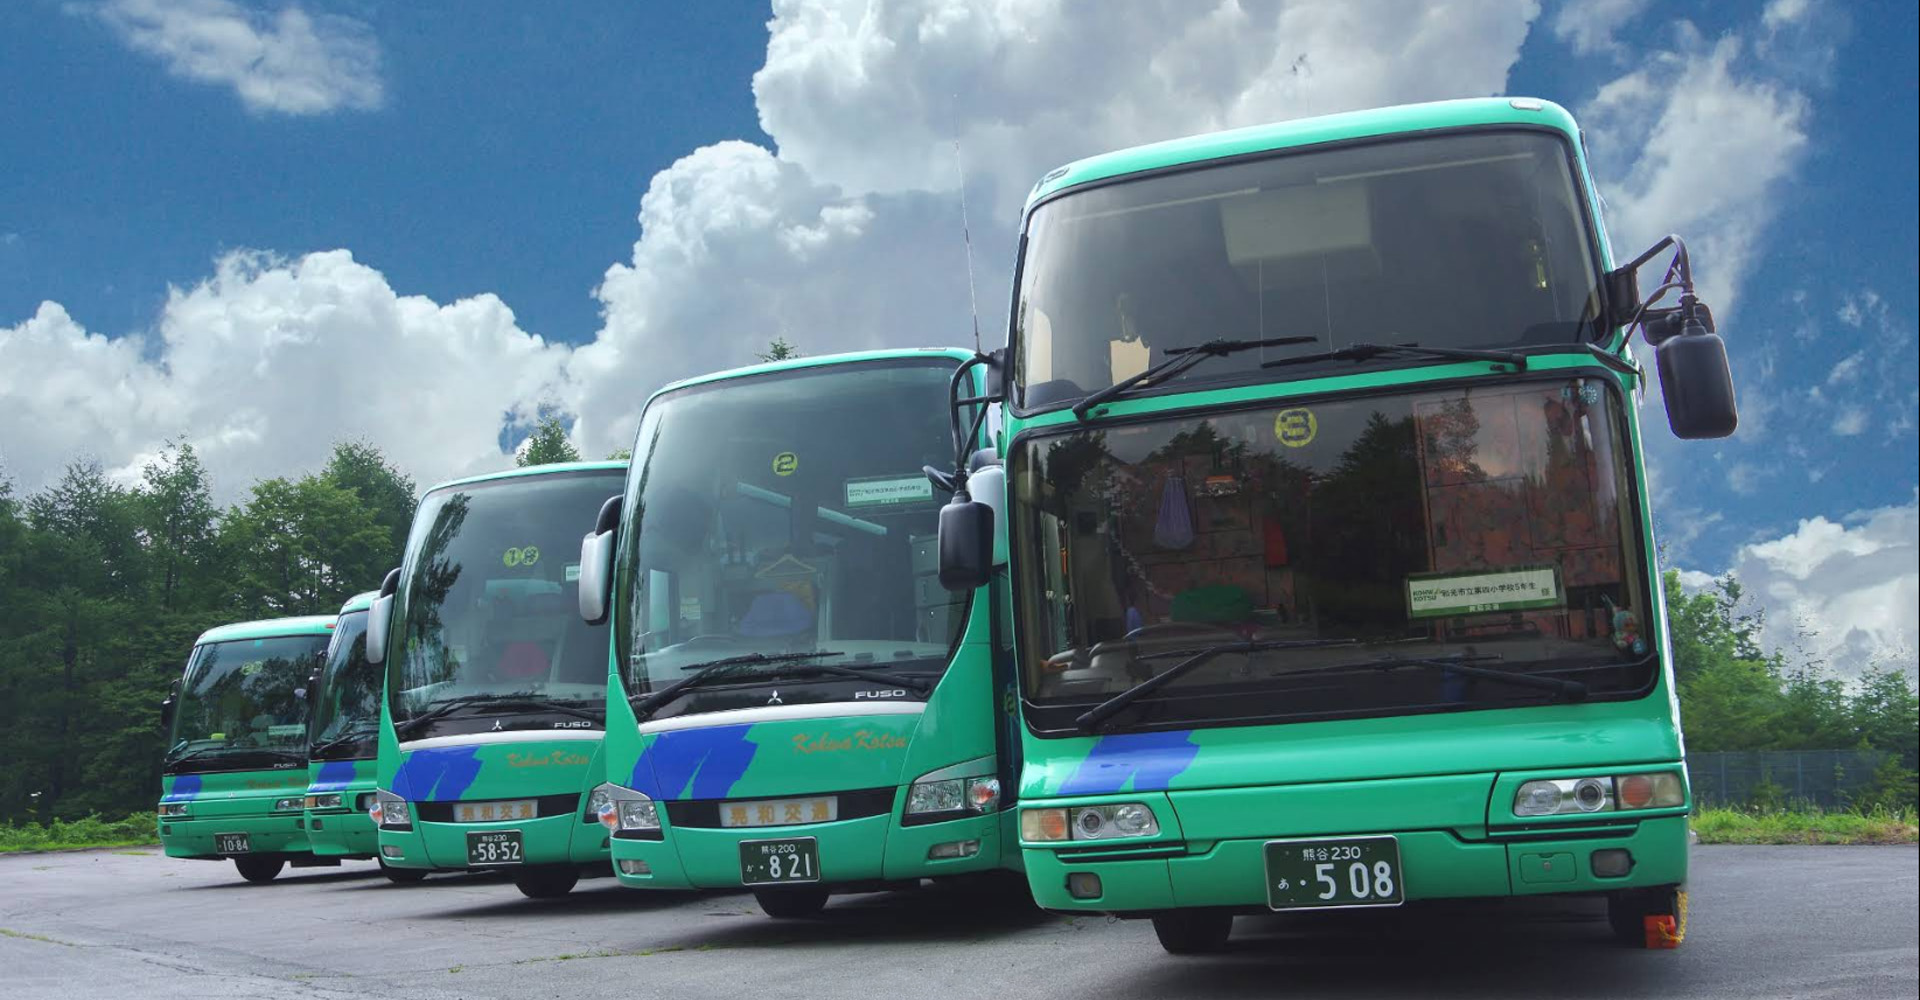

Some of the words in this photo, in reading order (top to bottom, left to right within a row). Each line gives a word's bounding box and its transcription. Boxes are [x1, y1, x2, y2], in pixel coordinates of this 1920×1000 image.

[1281, 411, 1311, 441] 3
[776, 454, 795, 473] 2
[855, 689, 907, 699] FUSO
[477, 842, 520, 861] 58-52
[778, 844, 795, 853] 200
[1303, 848, 1329, 861] 熊谷
[1331, 846, 1361, 860] 230
[1278, 878, 1289, 890] あ
